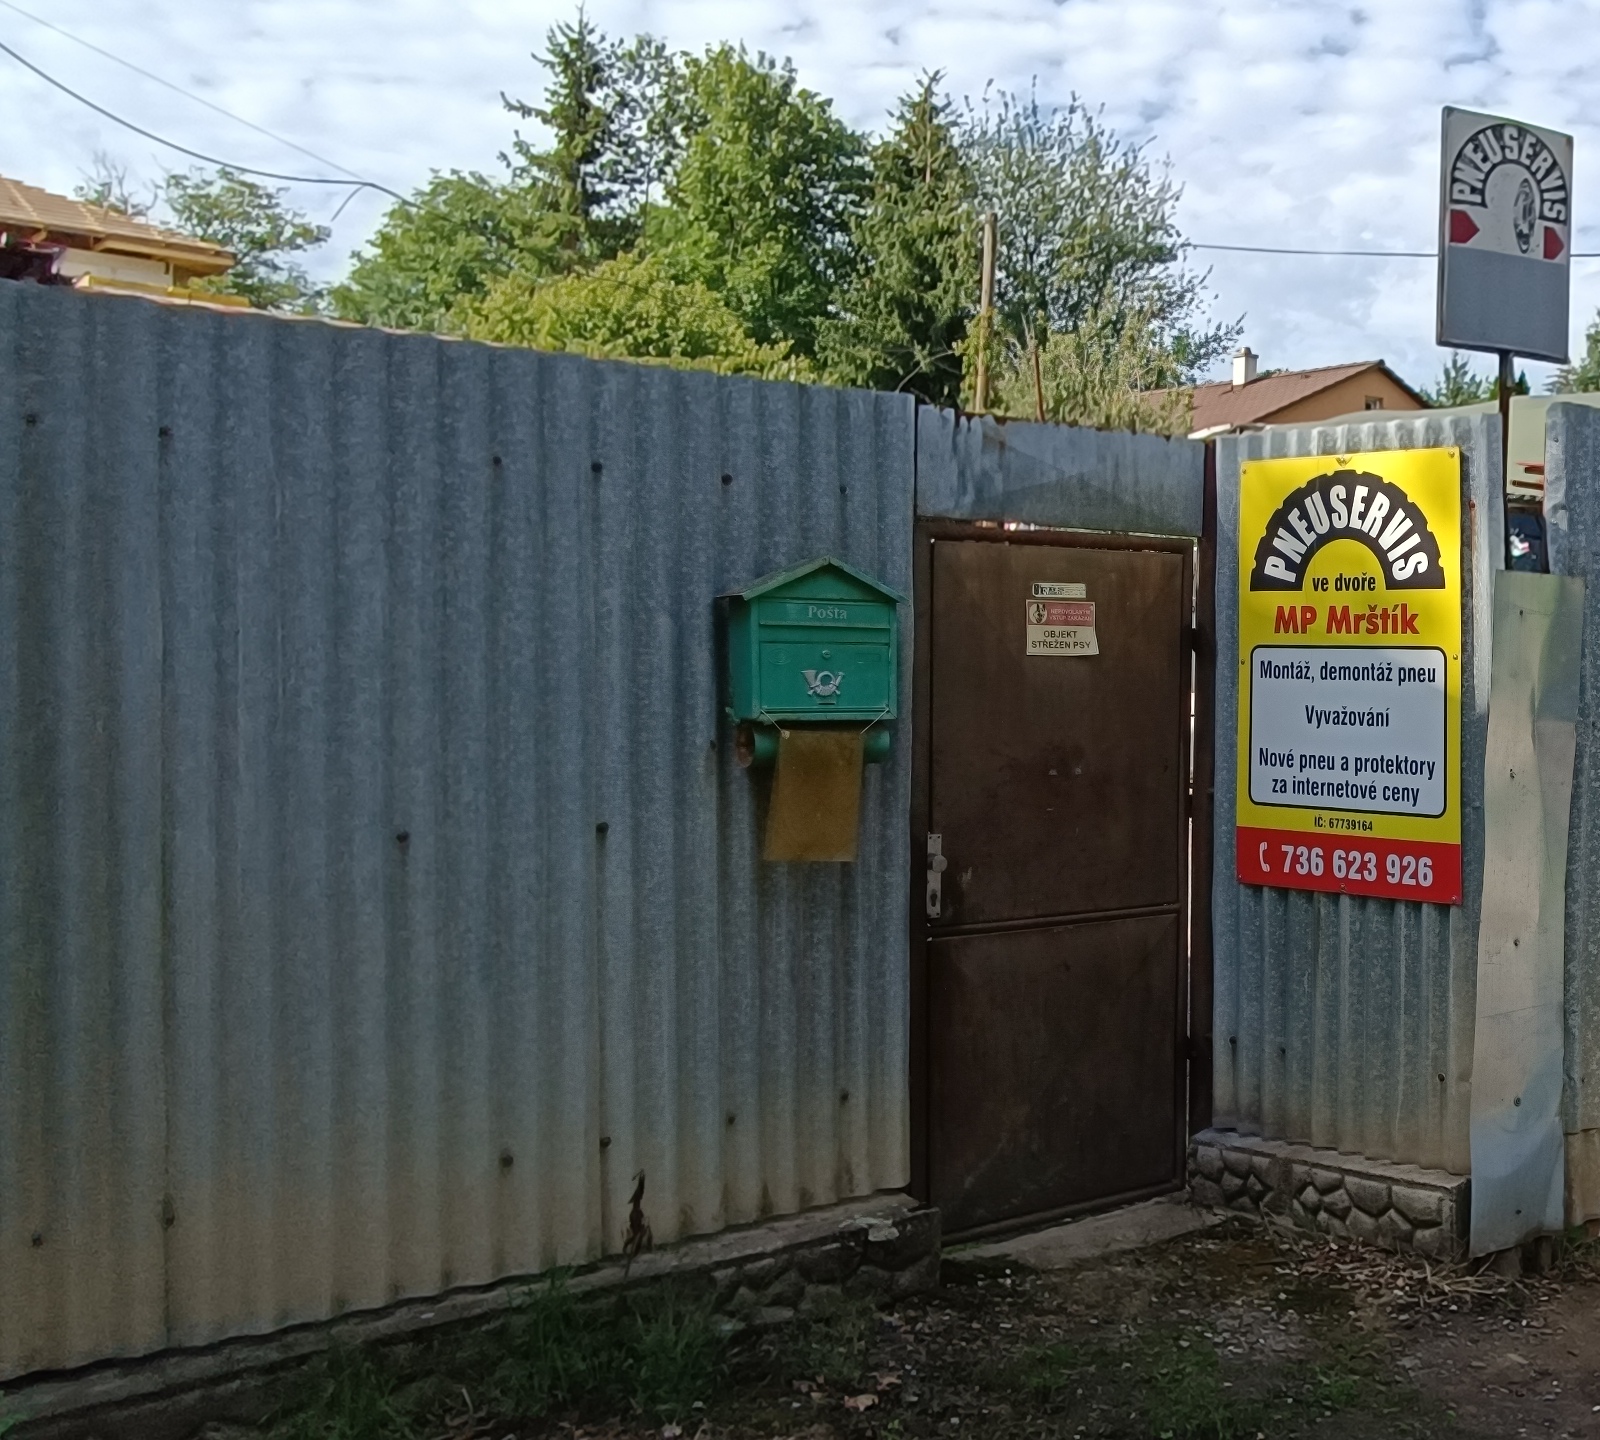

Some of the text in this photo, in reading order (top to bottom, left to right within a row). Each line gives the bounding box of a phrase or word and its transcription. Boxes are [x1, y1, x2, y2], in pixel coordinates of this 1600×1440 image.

[1452, 125, 1567, 222] PNEUSERVIS
[1263, 484, 1429, 583] PNEUSERVIS
[1312, 572, 1376, 592] ve dvoře
[807, 605, 848, 620] Pošta
[1273, 603, 1420, 635] MP Mrštík
[1031, 639, 1091, 649] STŘEŽEN PSY
[1043, 630, 1078, 638] OBJEKT
[1260, 660, 1436, 686] Montáž, demontáž pneu
[1304, 705, 1390, 729] Vyvažování
[1259, 748, 1436, 780] Nové pneu a protektory
[1271, 776, 1420, 807] za internetové ceny
[1314, 814, 1373, 831] IČ: 67739164
[1281, 844, 1433, 887] 736 623 926
